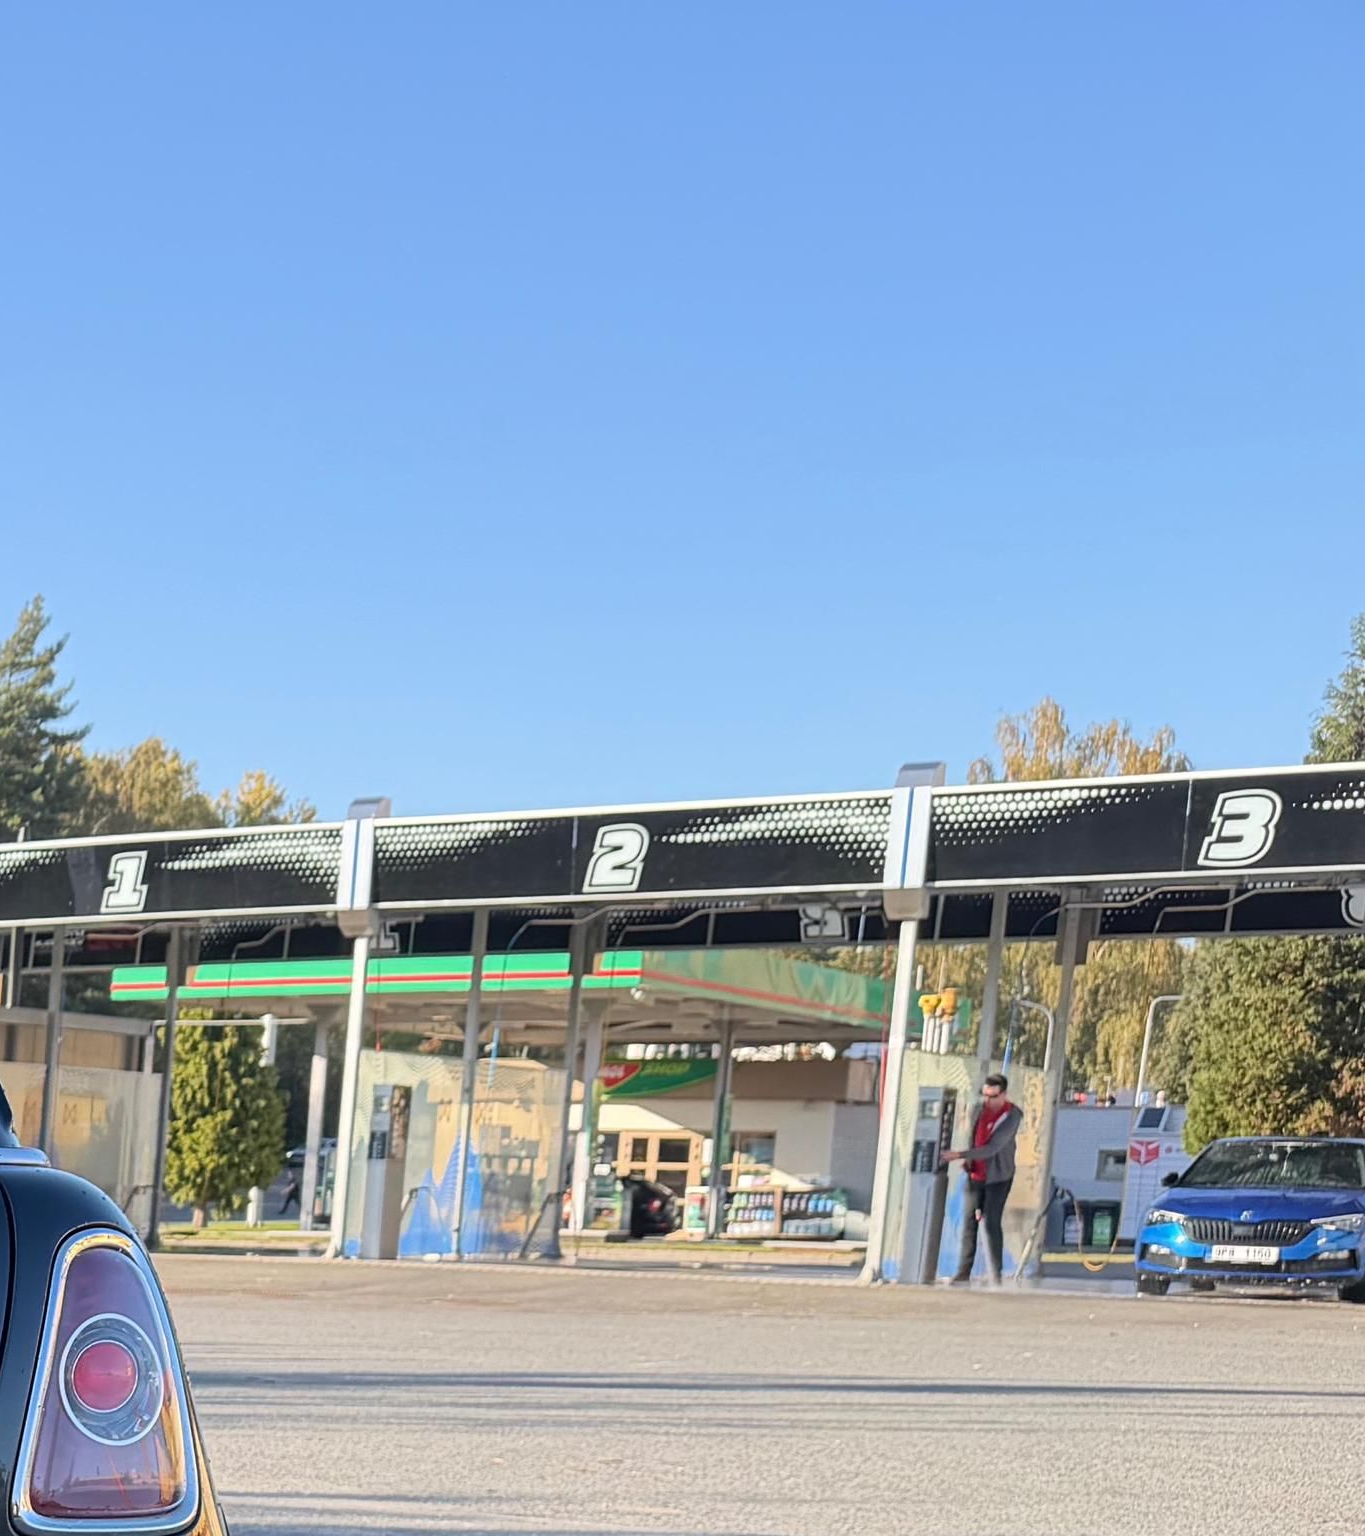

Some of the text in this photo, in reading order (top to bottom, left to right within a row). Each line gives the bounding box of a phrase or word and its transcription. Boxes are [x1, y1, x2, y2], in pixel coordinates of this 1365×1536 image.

[582, 823, 649, 893] 2
[1197, 788, 1282, 868] 3
[100, 850, 149, 915] 1
